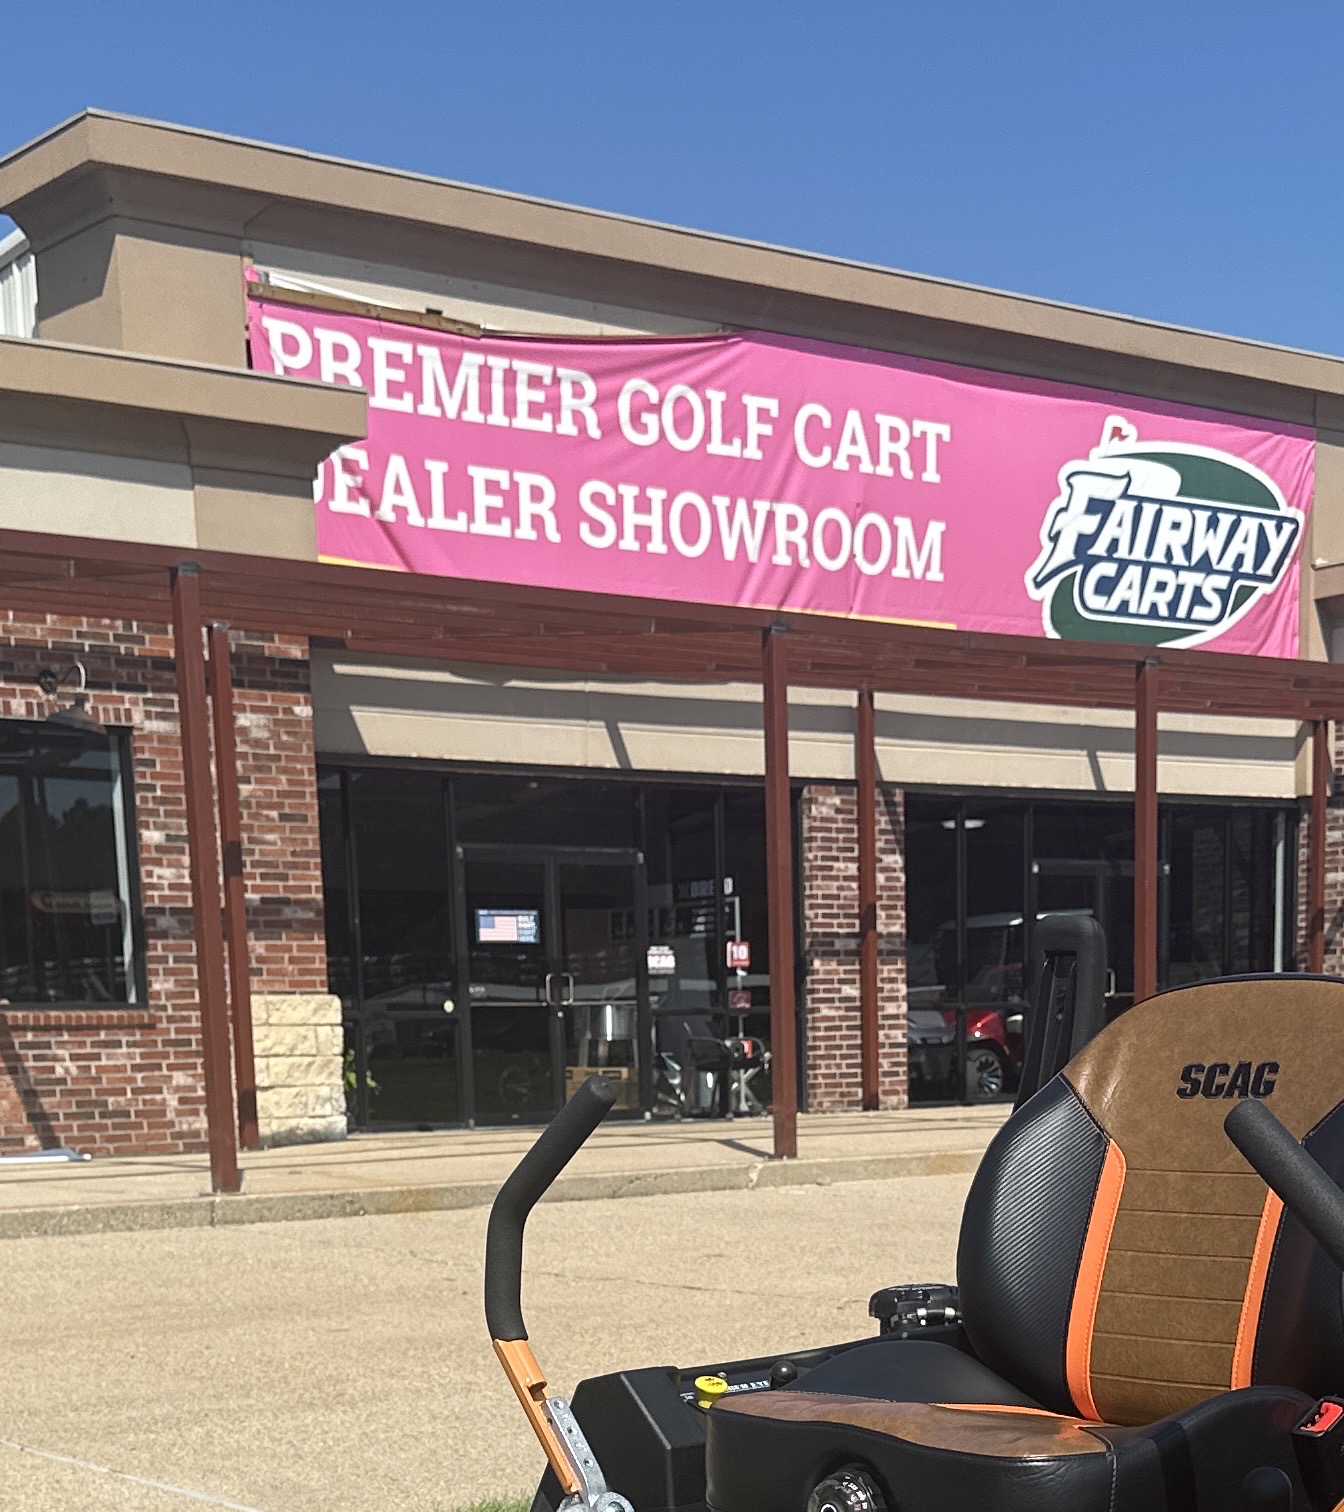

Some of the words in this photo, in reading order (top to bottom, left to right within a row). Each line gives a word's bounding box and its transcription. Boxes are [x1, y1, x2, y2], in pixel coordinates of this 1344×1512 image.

[261, 316, 602, 439] PREMIER
[617, 378, 778, 462] GOLF
[794, 401, 952, 484] CART
[313, 444, 562, 543] EALER
[578, 478, 947, 583] SHOWROOM
[1034, 471, 1298, 587] FAIRWAY
[1083, 562, 1230, 621] CARTS
[1176, 1061, 1280, 1099] SCAG
